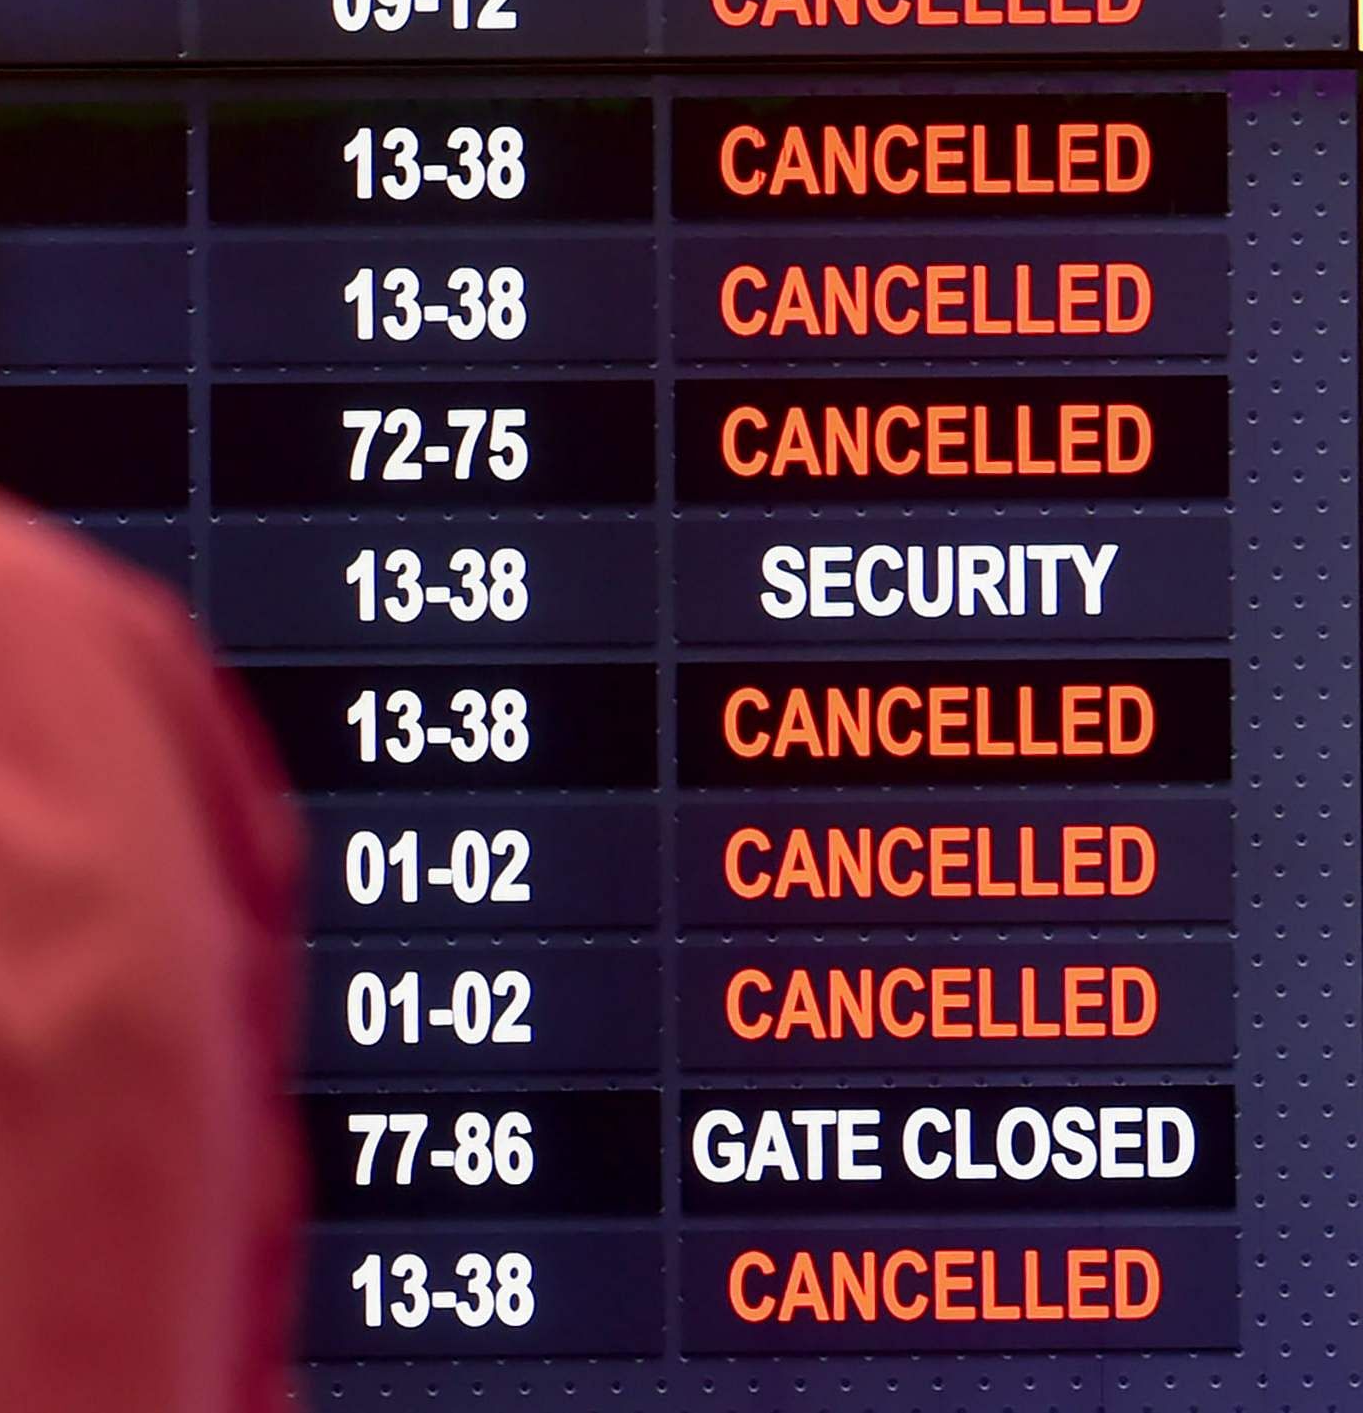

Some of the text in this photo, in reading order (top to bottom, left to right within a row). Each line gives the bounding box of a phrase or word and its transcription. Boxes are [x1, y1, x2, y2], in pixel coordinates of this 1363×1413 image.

[343, 126, 526, 201] 13-38
[719, 123, 1152, 196] CANCELLED
[344, 266, 527, 341] 13-38
[720, 262, 1153, 337] CANCELLED
[342, 408, 529, 481] 72-75
[721, 403, 1153, 477] CANCELLED
[346, 548, 529, 623] 13-38
[760, 544, 1119, 619] SECURITY
[347, 688, 530, 763] 13-38
[723, 684, 1156, 758] CANCELLED
[346, 829, 531, 905] 01-02
[724, 825, 1157, 900] CANCELLED
[347, 970, 532, 1046] 01-02
[725, 966, 1158, 1040] CANCELLED
[348, 1111, 534, 1186] 77-86
[692, 1106, 1195, 1183] GATE CLOSED
[352, 1252, 535, 1328] 13-38
[728, 1248, 1161, 1323] CANCELLED
